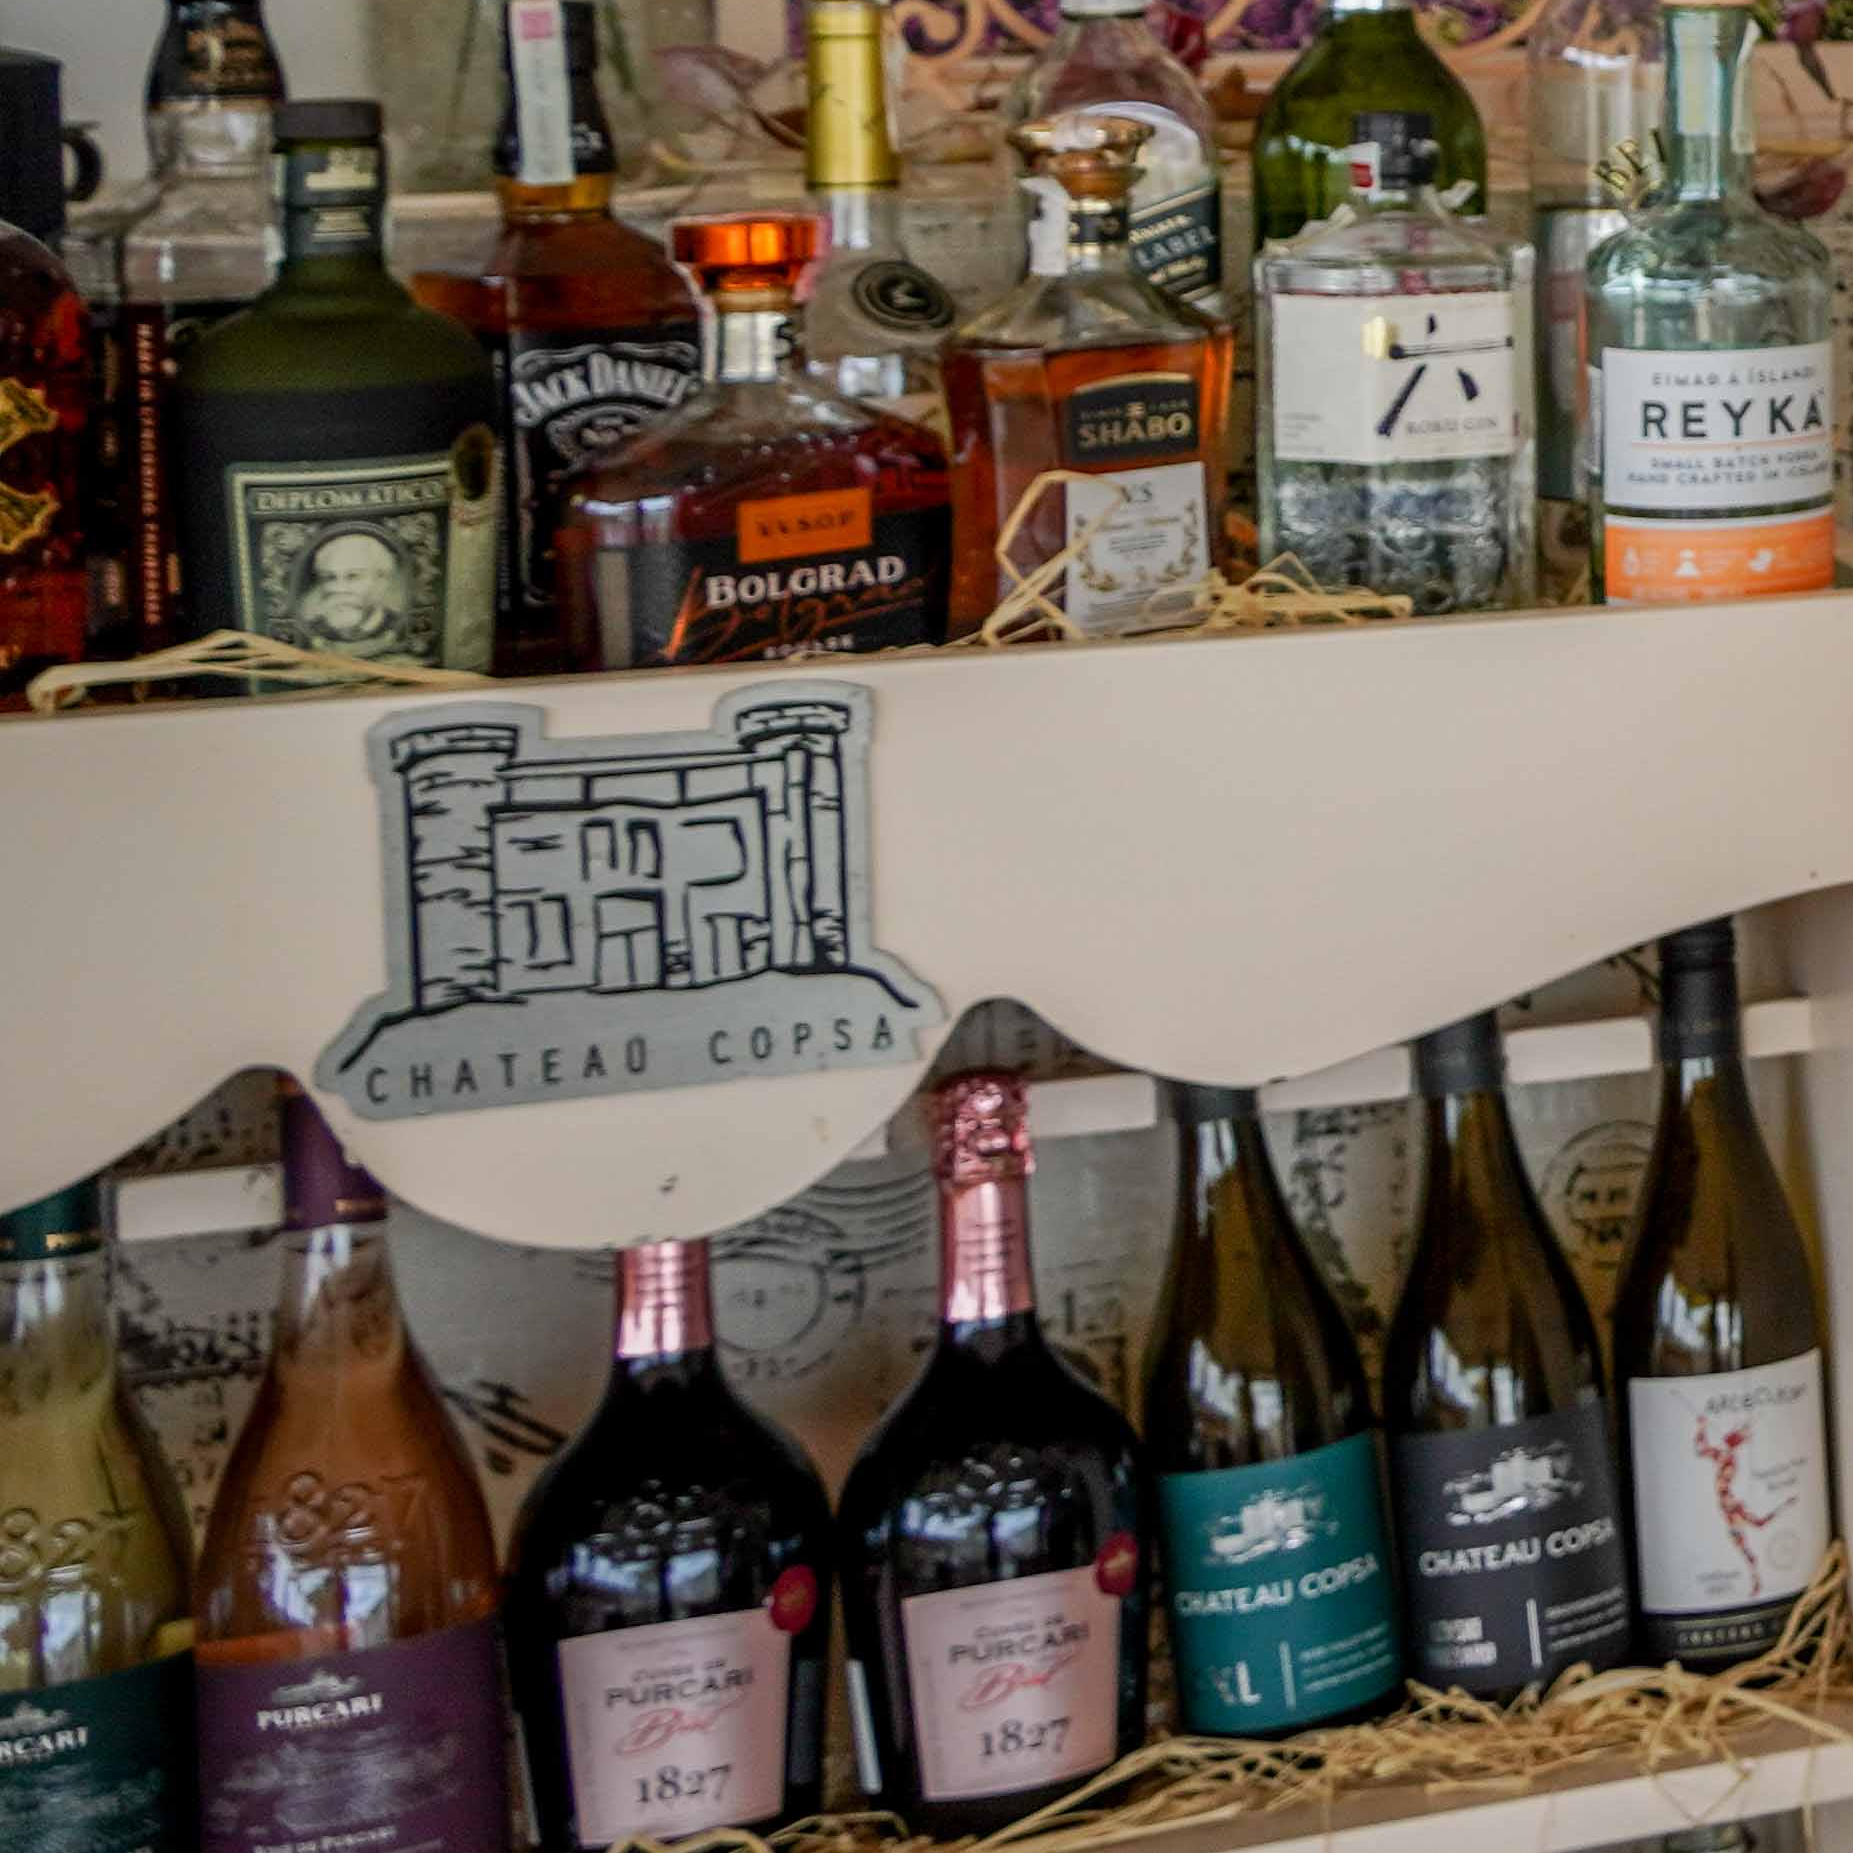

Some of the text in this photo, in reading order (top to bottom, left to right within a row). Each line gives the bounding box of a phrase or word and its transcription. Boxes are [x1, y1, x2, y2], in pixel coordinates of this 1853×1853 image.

[1078, 412, 1193, 449] SHABO
[1641, 395, 1824, 438] REYKA
[706, 556, 908, 609] BOLGRAD
[709, 1014, 895, 1066] COPSA
[1420, 1537, 1542, 1578] CHATEAU
[1174, 1579, 1294, 1617] CHATEAU
[949, 1620, 1090, 1664] PURCARI
[605, 1666, 755, 1707] PURCARI
[256, 1693, 384, 1731] PURCARI
[979, 1715, 1072, 1758] 1827
[636, 1762, 733, 1803] 1827
